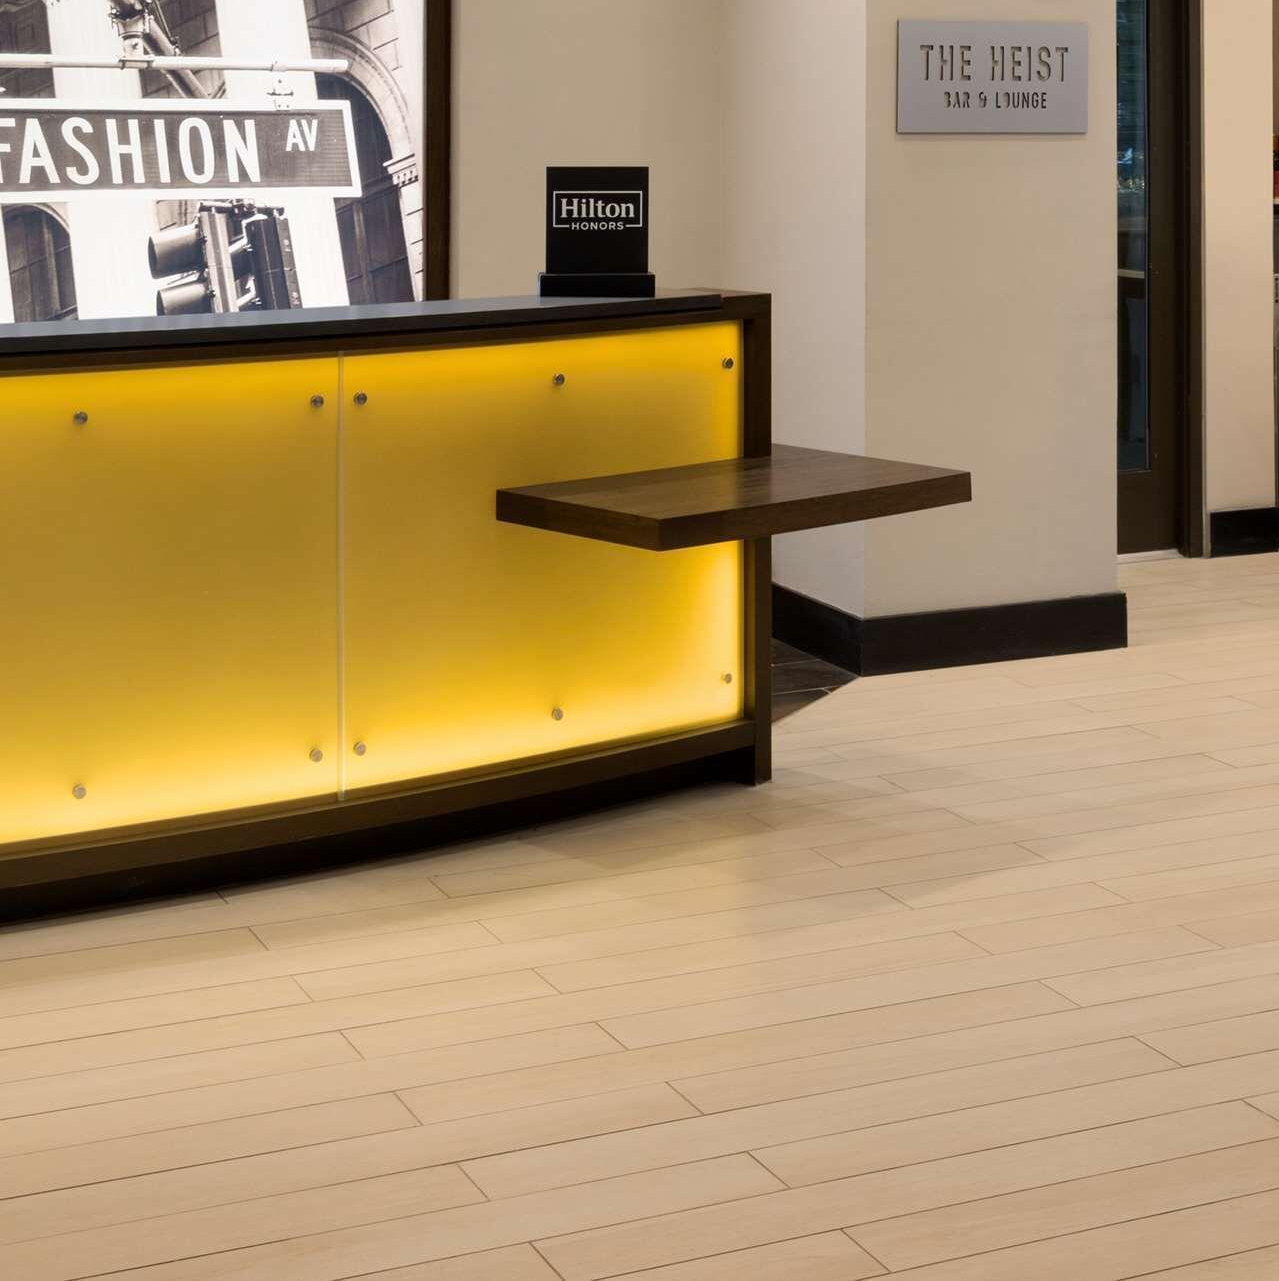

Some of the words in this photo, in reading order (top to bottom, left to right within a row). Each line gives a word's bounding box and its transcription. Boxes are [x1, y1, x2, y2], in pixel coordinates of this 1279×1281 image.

[920, 45, 972, 81] THE
[990, 46, 1069, 82] HEIST
[944, 91, 970, 109] BAR
[995, 92, 1048, 109] LOUNGE
[285, 119, 319, 153] AV
[560, 198, 636, 218] Hilton
[571, 221, 625, 231] HONORS
